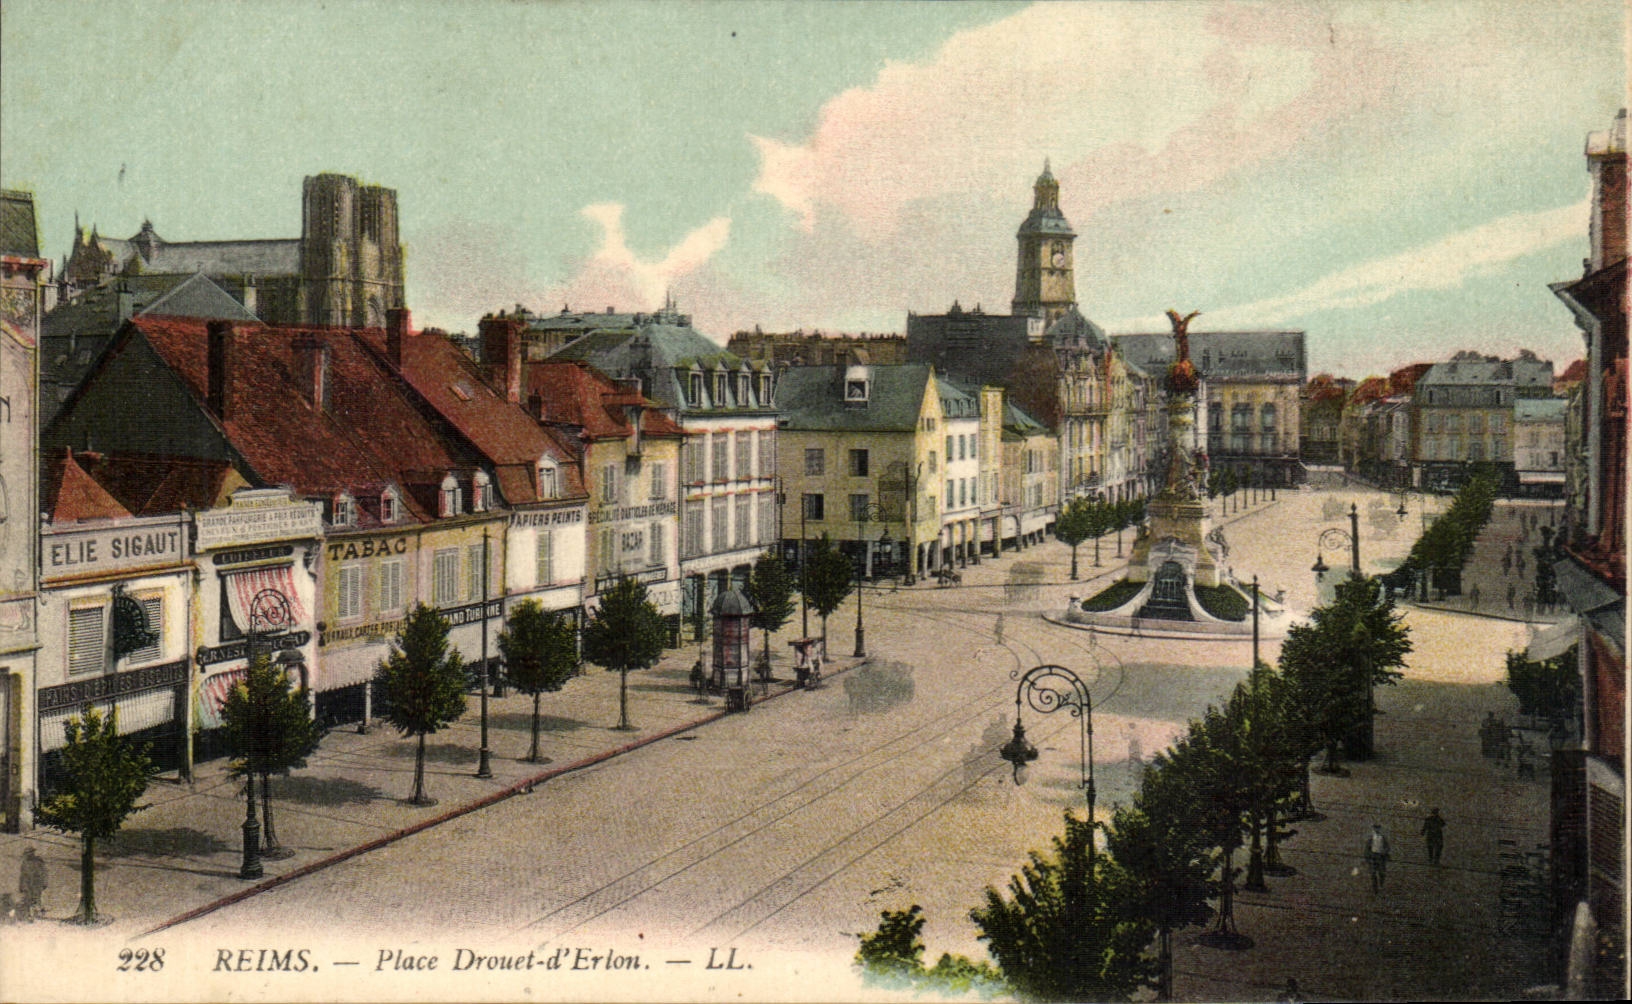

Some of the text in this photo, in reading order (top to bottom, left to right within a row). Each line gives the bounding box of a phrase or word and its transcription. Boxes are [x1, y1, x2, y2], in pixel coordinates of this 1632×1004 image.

[511, 509, 581, 528] PAPIERS PEINTS
[52, 540, 98, 566] ELIE
[111, 532, 177, 559] SIGAUT
[328, 536, 407, 561] TABAC
